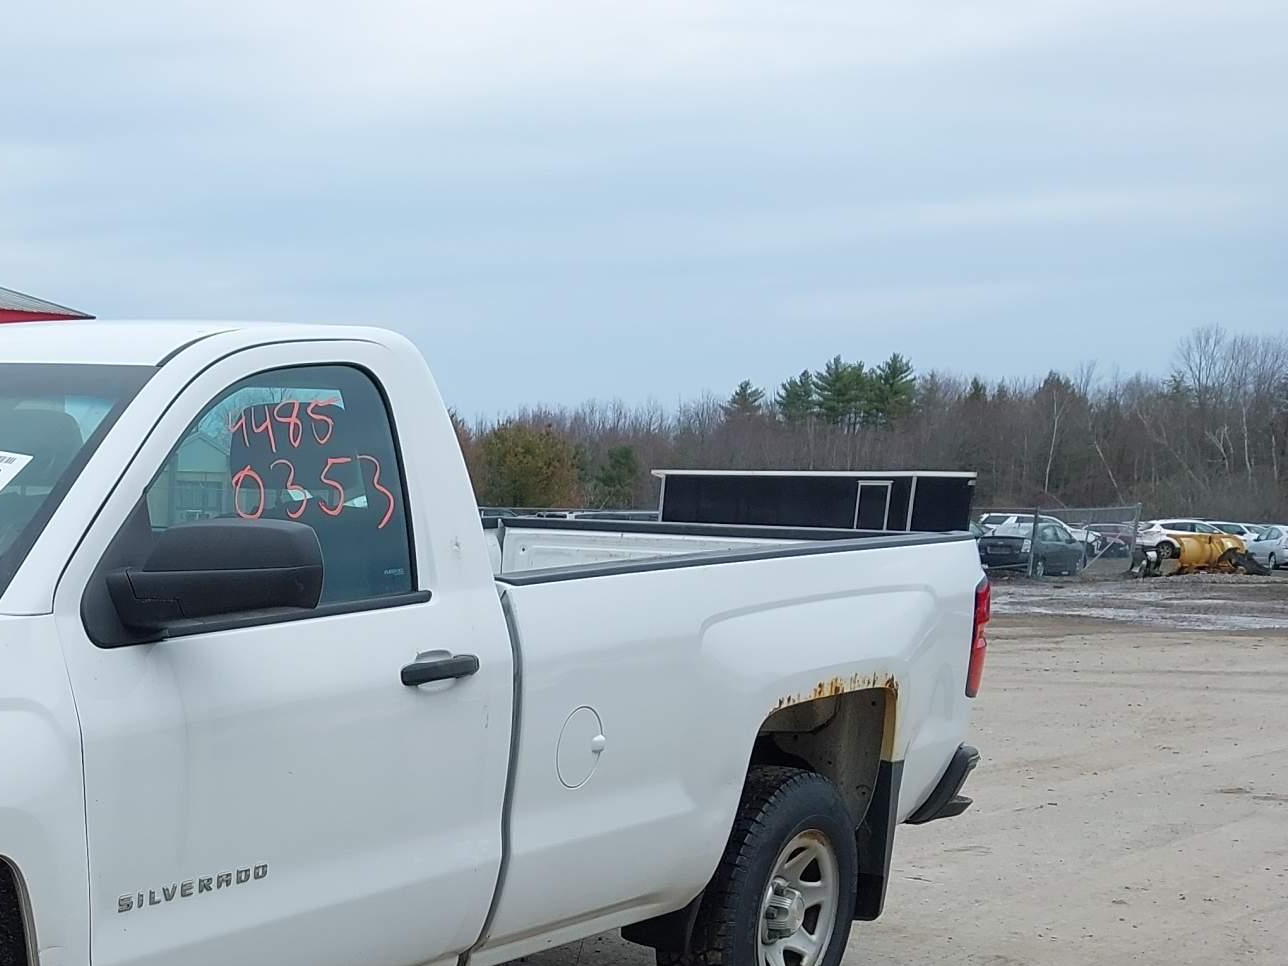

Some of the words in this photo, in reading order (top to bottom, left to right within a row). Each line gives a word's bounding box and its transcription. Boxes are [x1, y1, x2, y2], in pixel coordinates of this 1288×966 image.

[228, 399, 341, 453] 4485
[232, 455, 395, 529] 0353
[117, 863, 268, 913] SILVERADO
